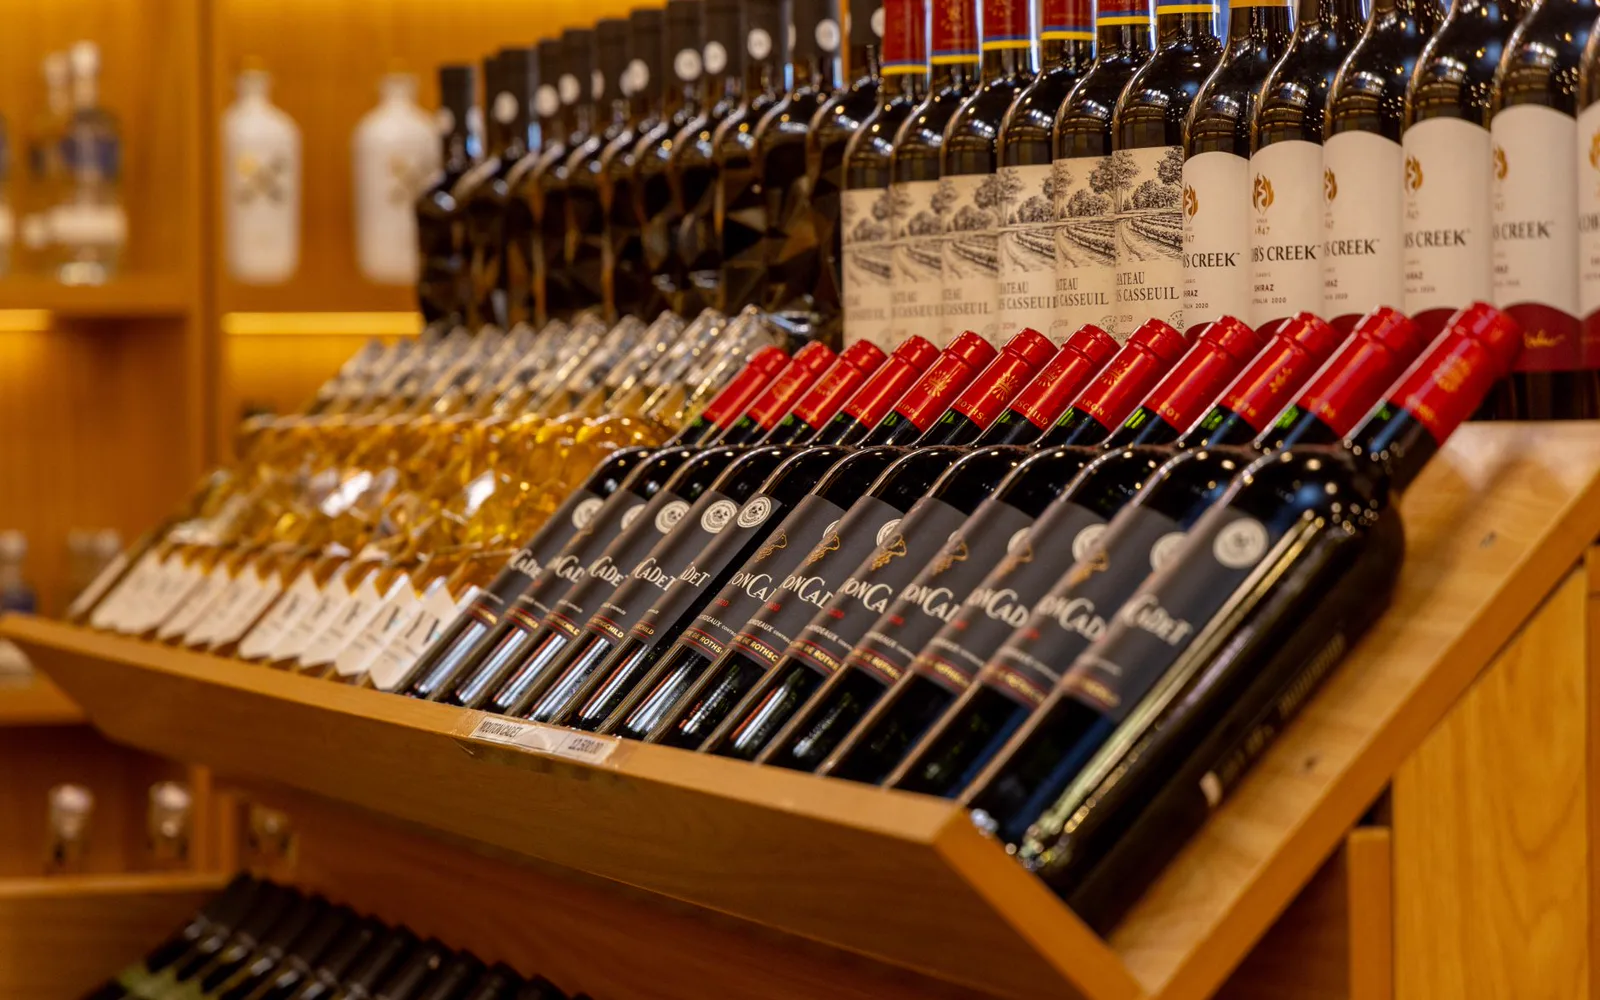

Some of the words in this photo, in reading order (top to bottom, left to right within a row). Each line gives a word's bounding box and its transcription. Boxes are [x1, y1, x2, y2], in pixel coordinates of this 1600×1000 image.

[1416, 230, 1466, 247] CREEK
[1267, 245, 1316, 261] CREEK
[1332, 240, 1375, 256] CREEK
[1192, 253, 1236, 268] CREEK
[1123, 287, 1180, 302] CASSEUIL
[633, 557, 678, 592] CADET
[751, 641, 779, 662] ROTHSC
